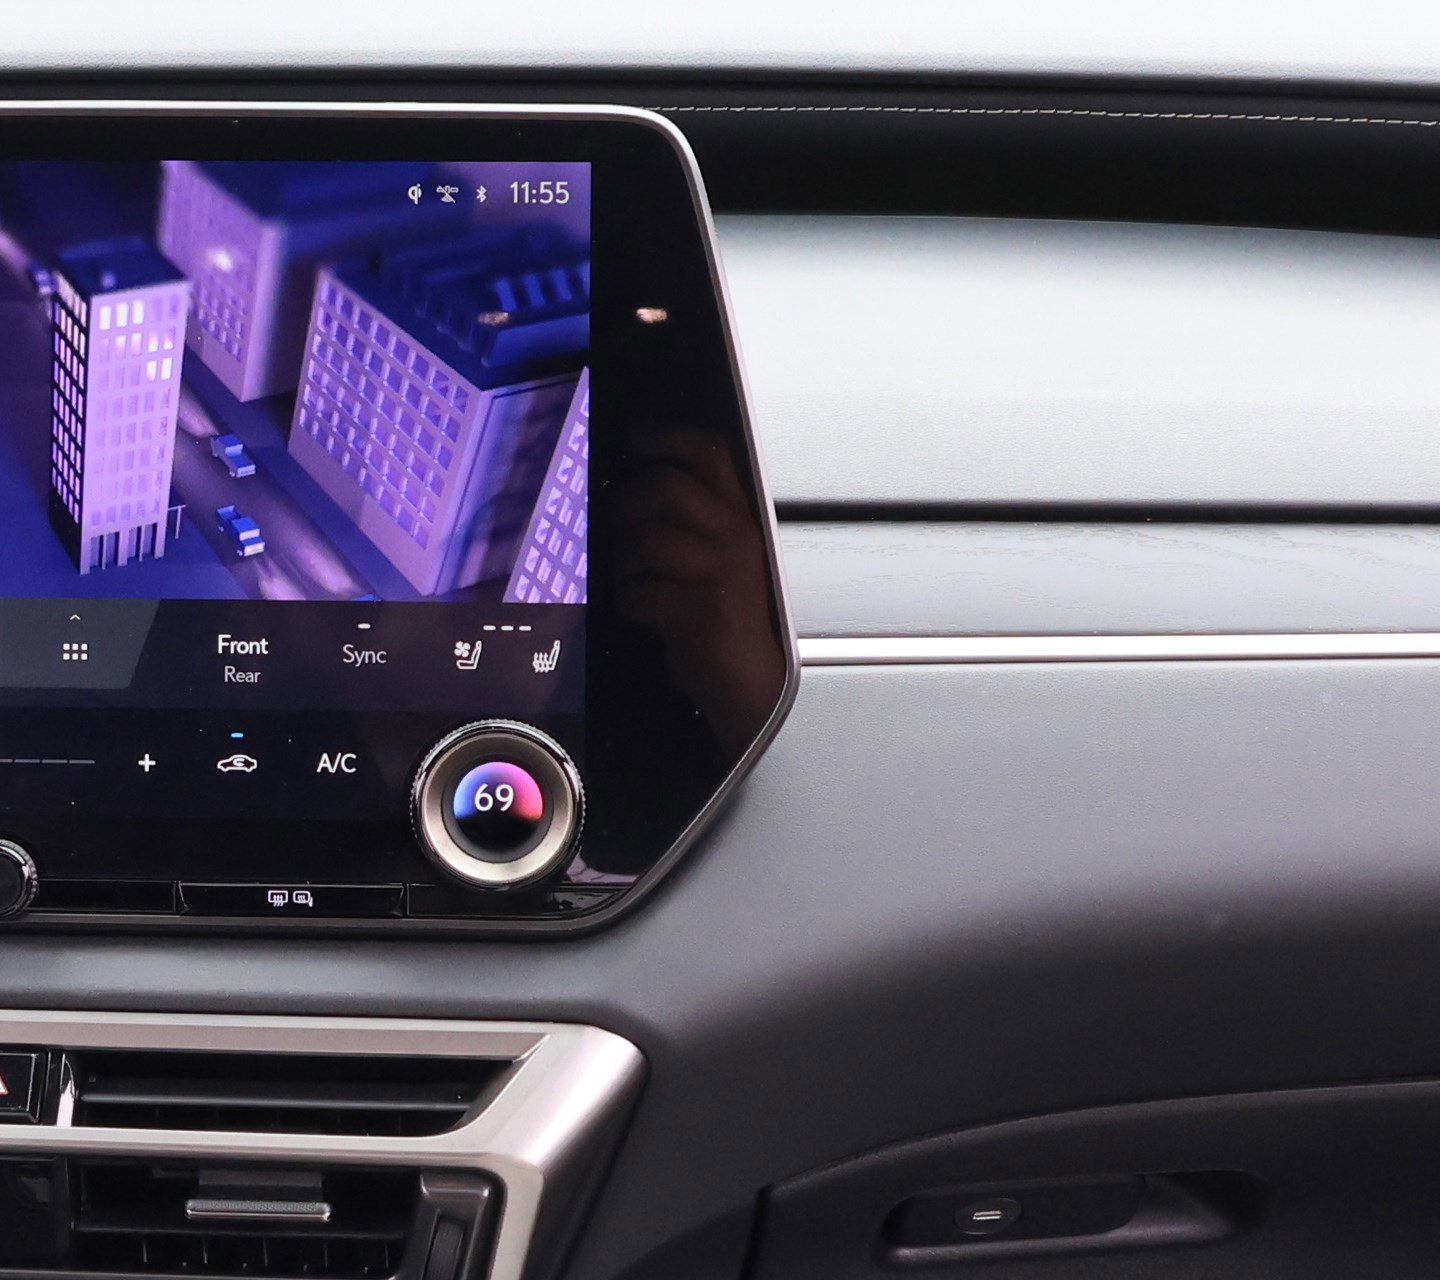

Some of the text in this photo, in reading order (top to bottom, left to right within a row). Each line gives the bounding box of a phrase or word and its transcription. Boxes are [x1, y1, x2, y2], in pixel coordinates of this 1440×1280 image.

[510, 181, 570, 204] 11:55
[217, 634, 269, 657] Front
[342, 644, 388, 666] Sync
[224, 666, 261, 685] Rear
[316, 752, 358, 775] A/C
[474, 783, 515, 813] 69
